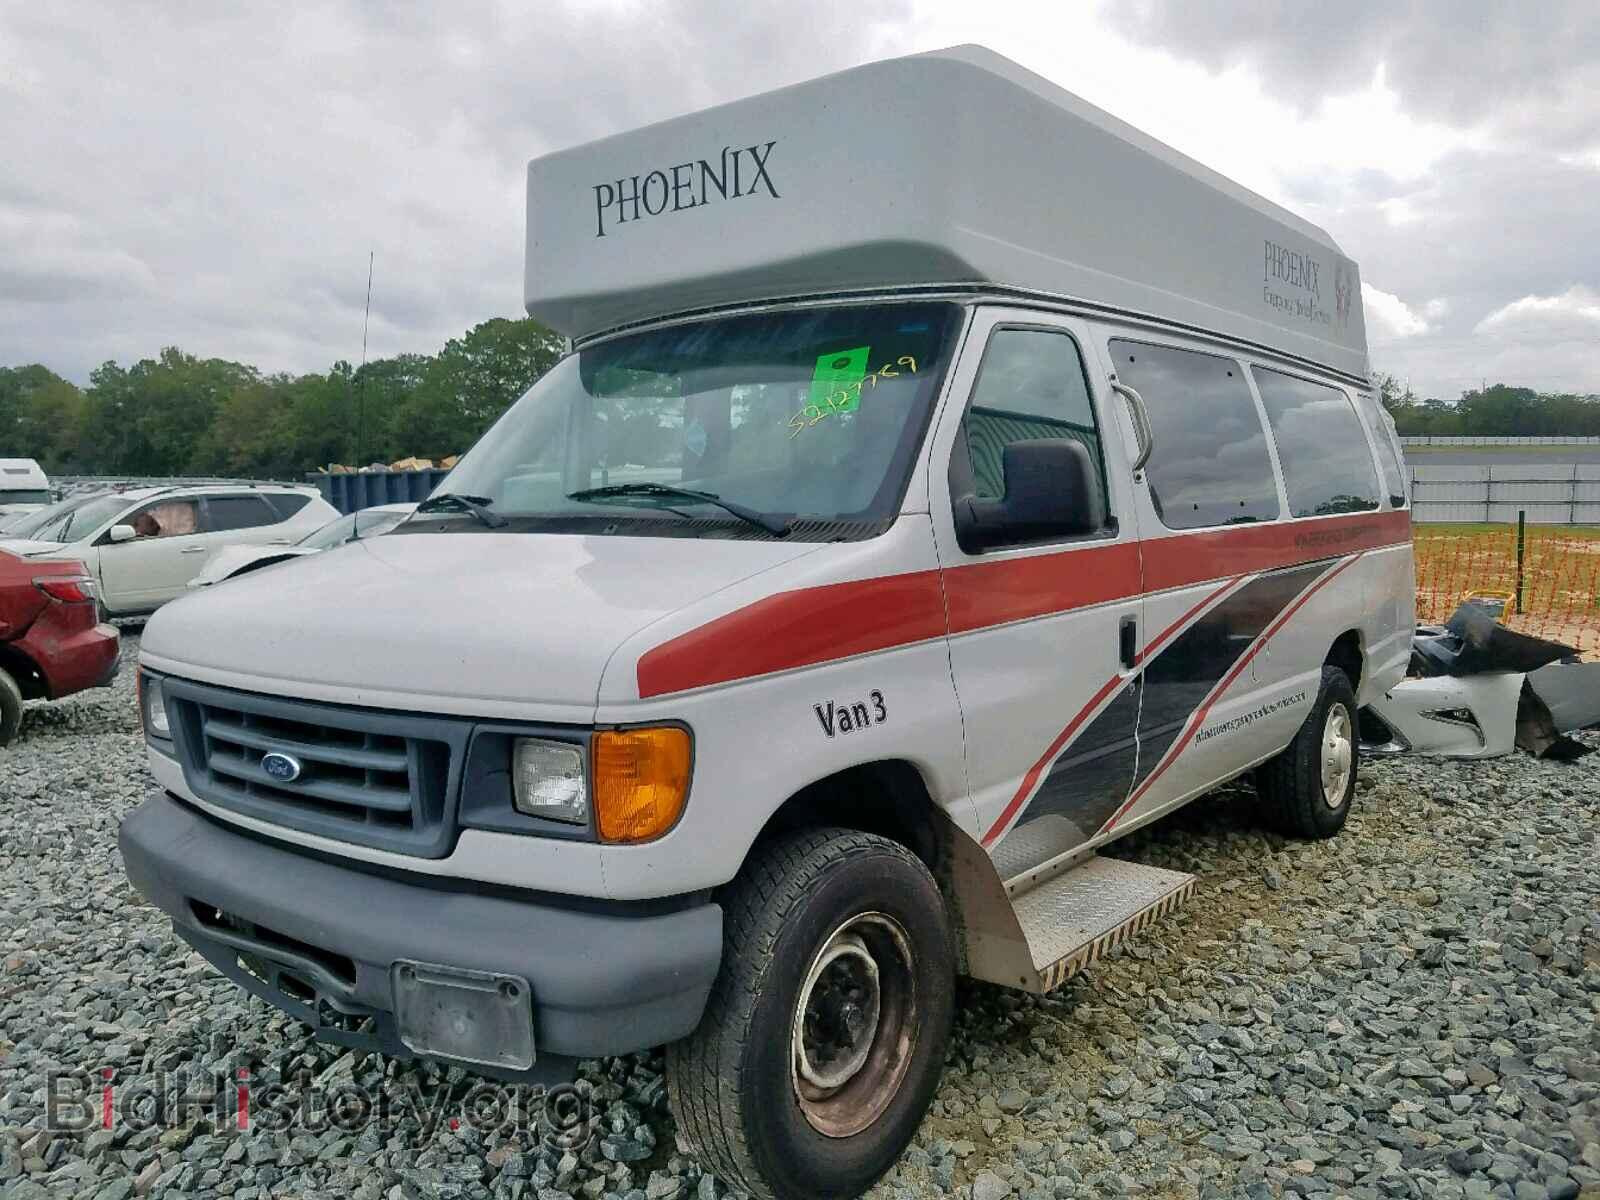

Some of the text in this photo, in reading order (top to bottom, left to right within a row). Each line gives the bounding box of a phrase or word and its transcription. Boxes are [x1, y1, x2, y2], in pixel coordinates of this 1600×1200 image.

[592, 141, 781, 237] PHOENIX
[1263, 240, 1320, 302] PHOENIX
[813, 691, 887, 737] Van 3
